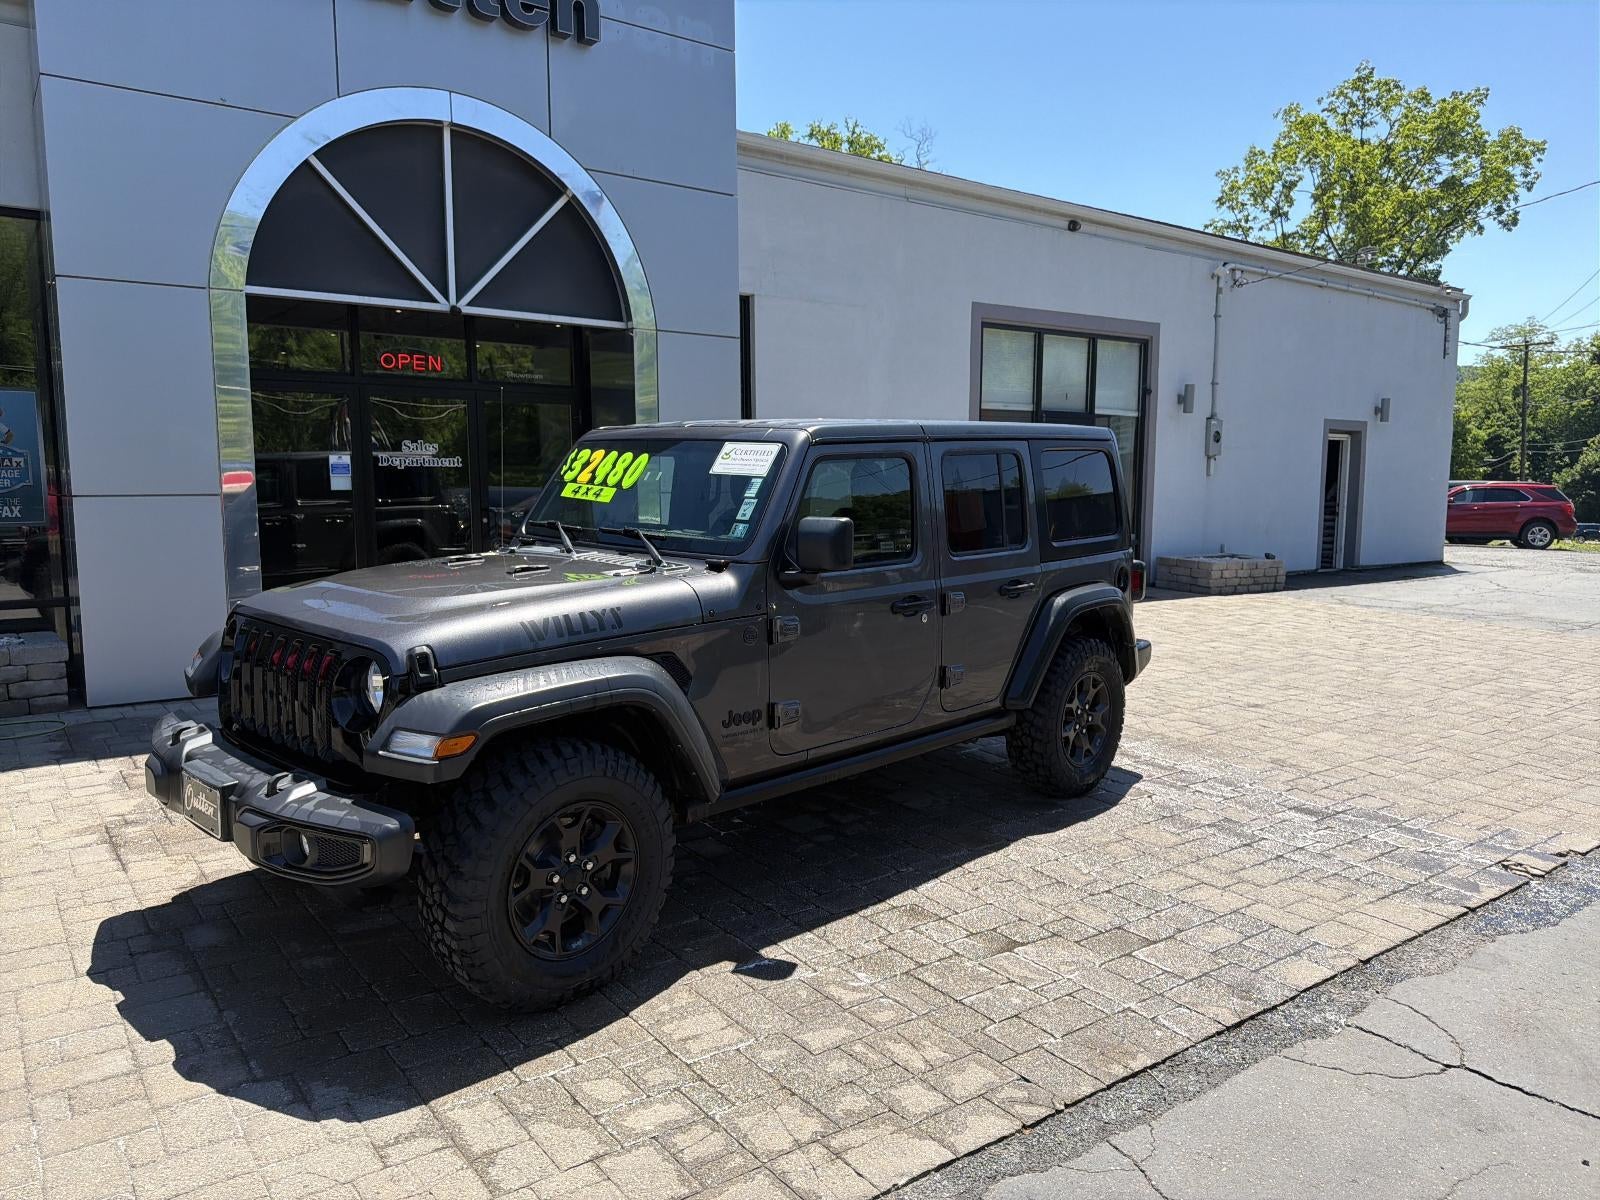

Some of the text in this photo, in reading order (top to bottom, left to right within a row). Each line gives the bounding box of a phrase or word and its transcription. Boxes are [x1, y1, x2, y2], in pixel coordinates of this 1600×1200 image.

[380, 352, 443, 372] OPEN
[401, 440, 439, 454] Sales
[378, 455, 462, 470] Department
[5, 497, 21, 506] THE
[520, 606, 624, 643] WILLYS
[721, 709, 763, 729] Jeep
[185, 783, 218, 821] Outten
